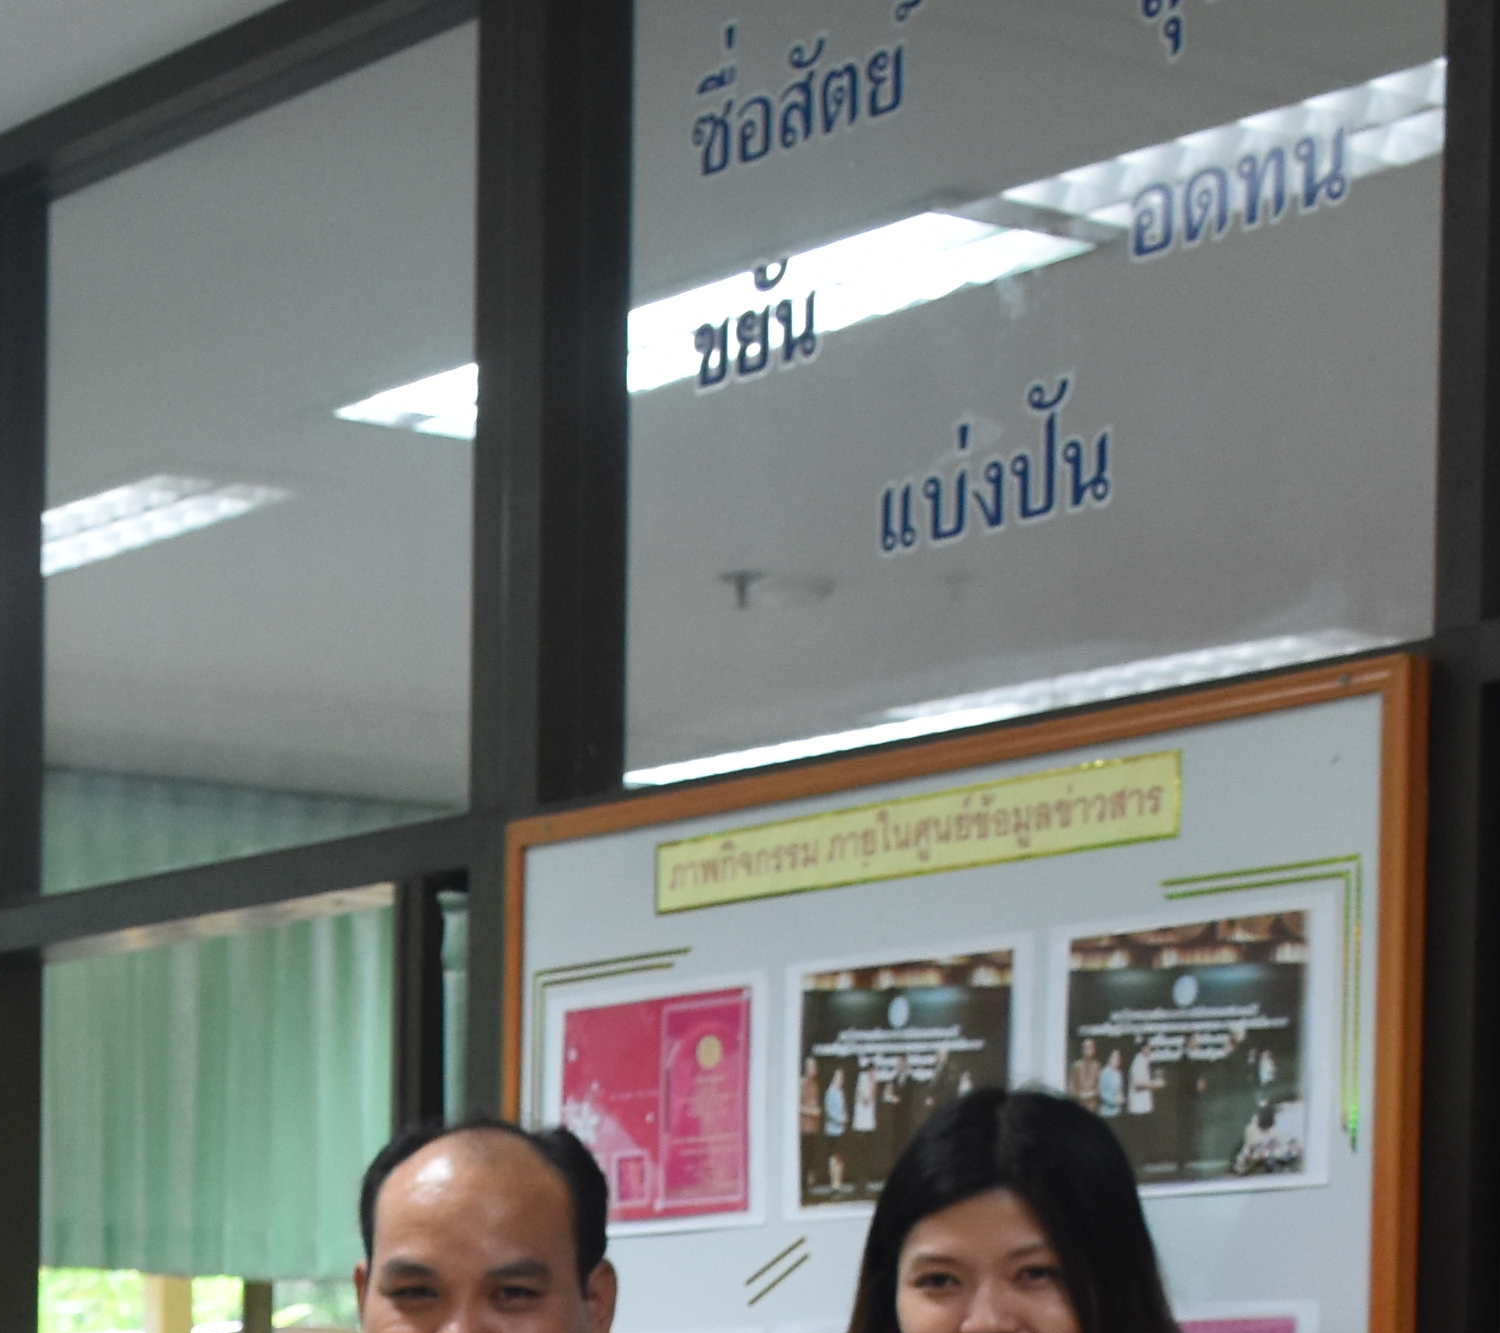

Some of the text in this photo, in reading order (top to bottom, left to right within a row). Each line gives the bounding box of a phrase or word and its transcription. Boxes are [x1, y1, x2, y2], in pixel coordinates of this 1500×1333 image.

[1128, 124, 1350, 258] อดทน
[694, 260, 818, 388] ขยัน
[879, 378, 1112, 552] แบ่งปัน
